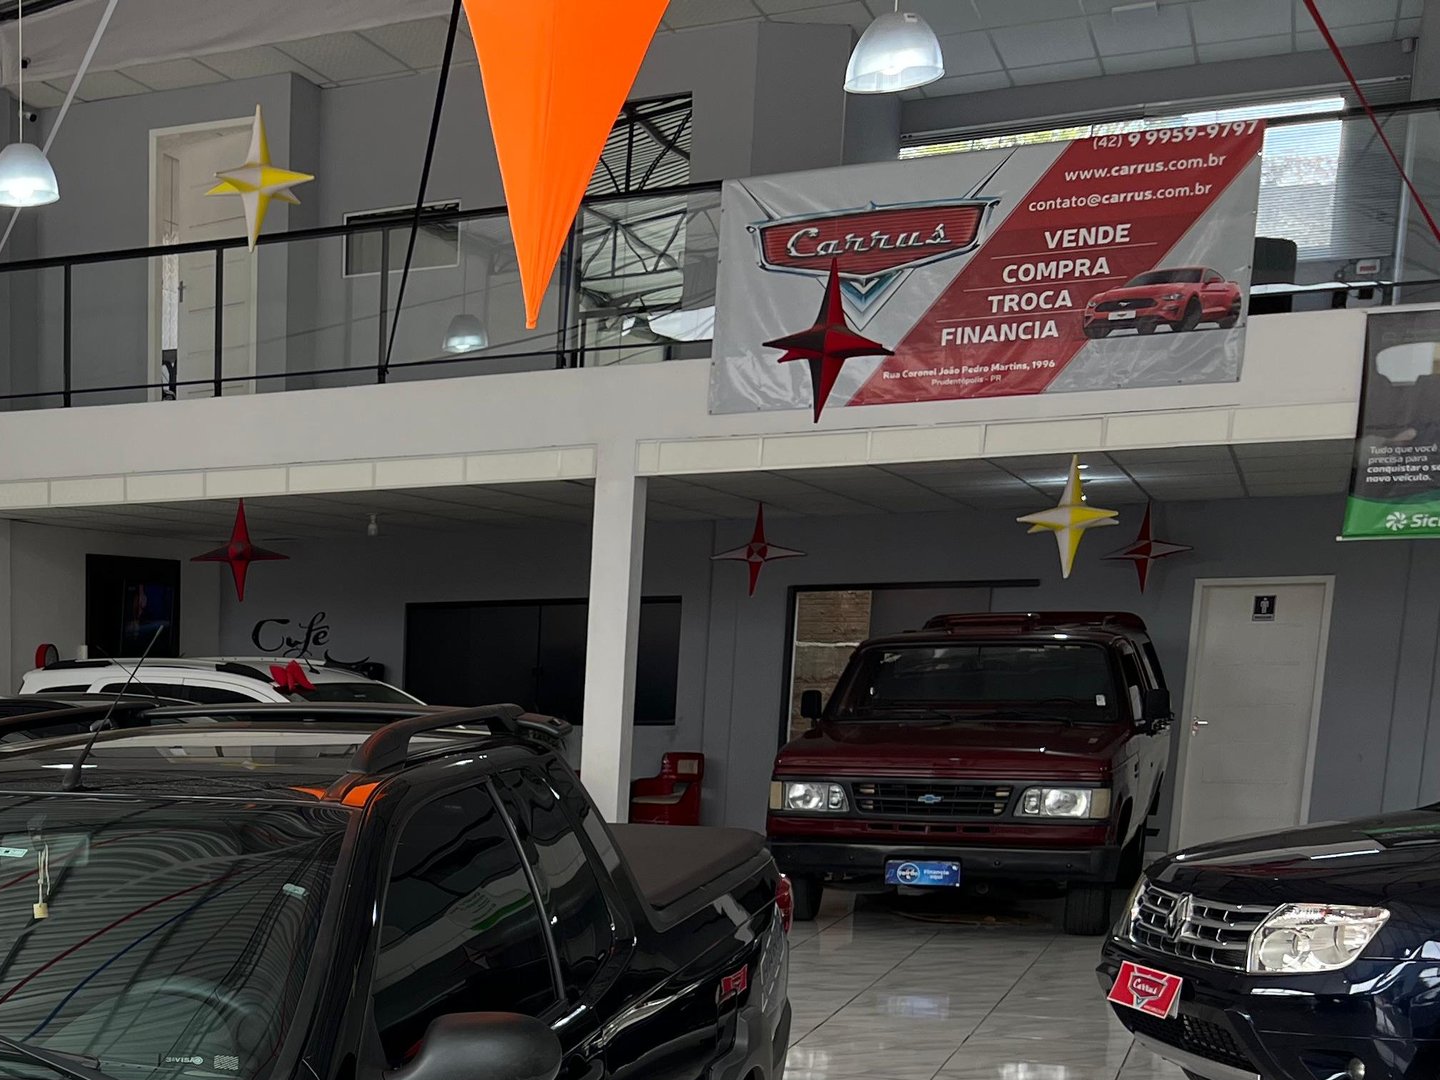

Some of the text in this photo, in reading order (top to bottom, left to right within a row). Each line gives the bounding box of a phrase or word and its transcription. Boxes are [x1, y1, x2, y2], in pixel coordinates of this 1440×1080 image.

[1093, 120, 1258, 150] (42) 9 9959-9797
[1065, 153, 1226, 181] www.carrus.com.br
[1028, 182, 1212, 212] contato@carrus.com.br
[786, 223, 952, 258] Carrus
[1044, 223, 1132, 249] VENDE
[1002, 257, 1110, 283] COMPRA
[987, 289, 1072, 313] TROCA
[941, 320, 1059, 346] FINANCIA
[882, 359, 1056, 380] Rua Coronel João Pedro Martins, 1996
[990, 374, 1002, 383] PR
[1368, 455, 1428, 465] precisa para
[1369, 443, 1438, 455] Tudo que você
[1366, 475, 1391, 483] novo
[1367, 464, 1421, 474] conquistar
